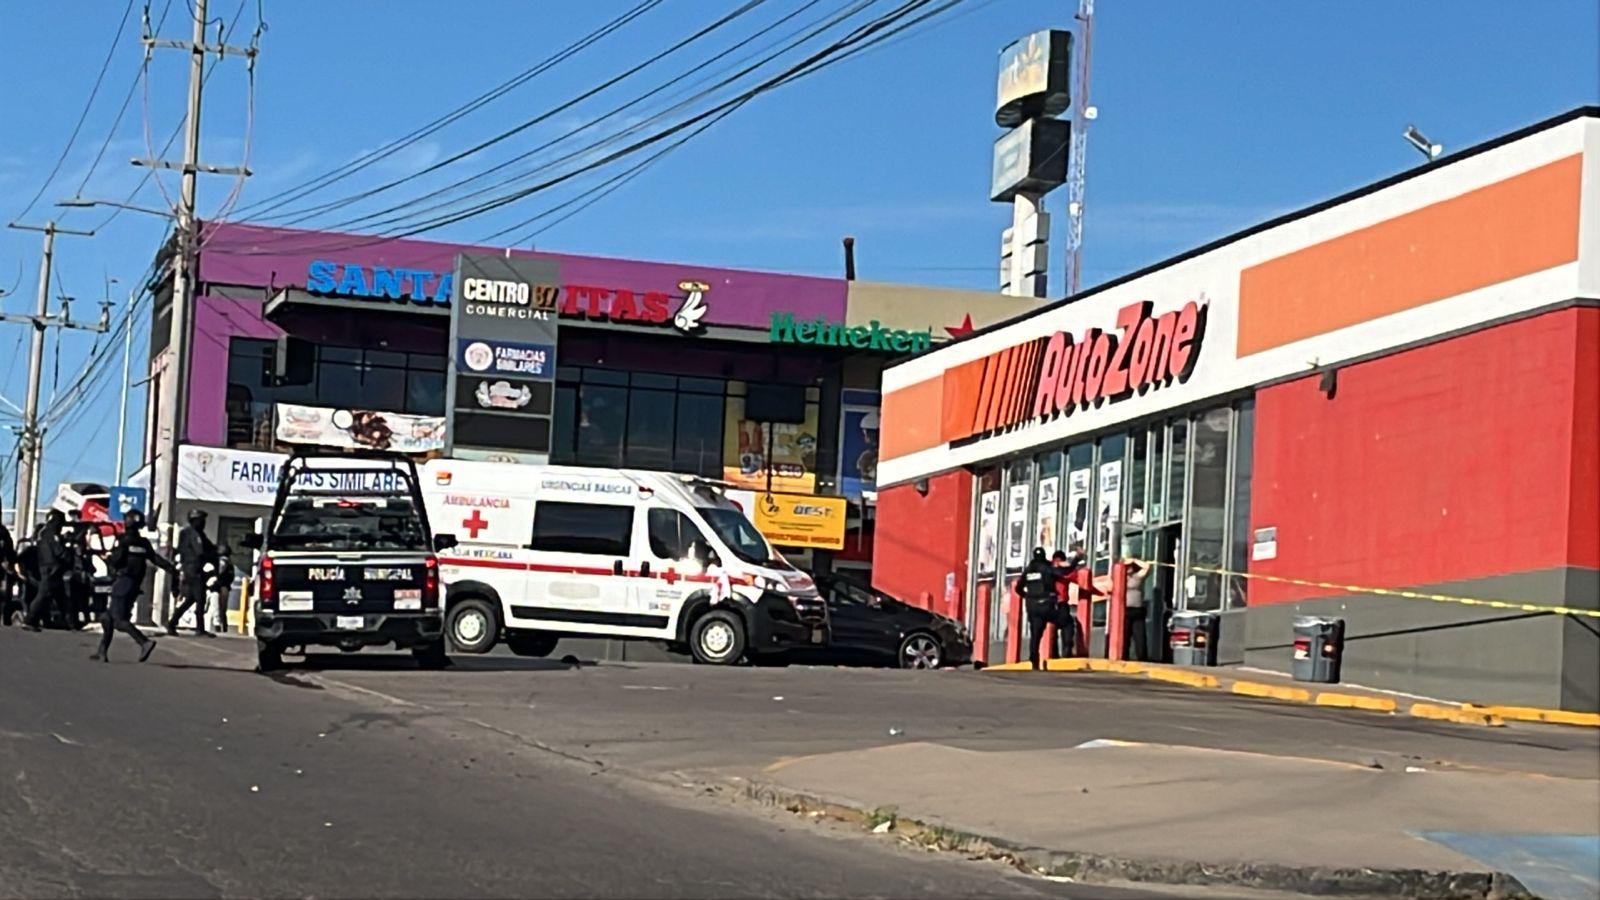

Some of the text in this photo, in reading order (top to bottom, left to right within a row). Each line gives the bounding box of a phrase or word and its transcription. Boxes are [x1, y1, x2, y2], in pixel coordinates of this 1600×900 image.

[464, 277, 529, 305] CENTRO
[558, 285, 669, 324] ITAS
[465, 304, 549, 320] COMERCIAL
[770, 311, 931, 353] Heineken
[1032, 300, 1202, 418] AutoZone
[443, 494, 510, 509] AMBULANCIA
[364, 567, 413, 580] MUNICIPAL
